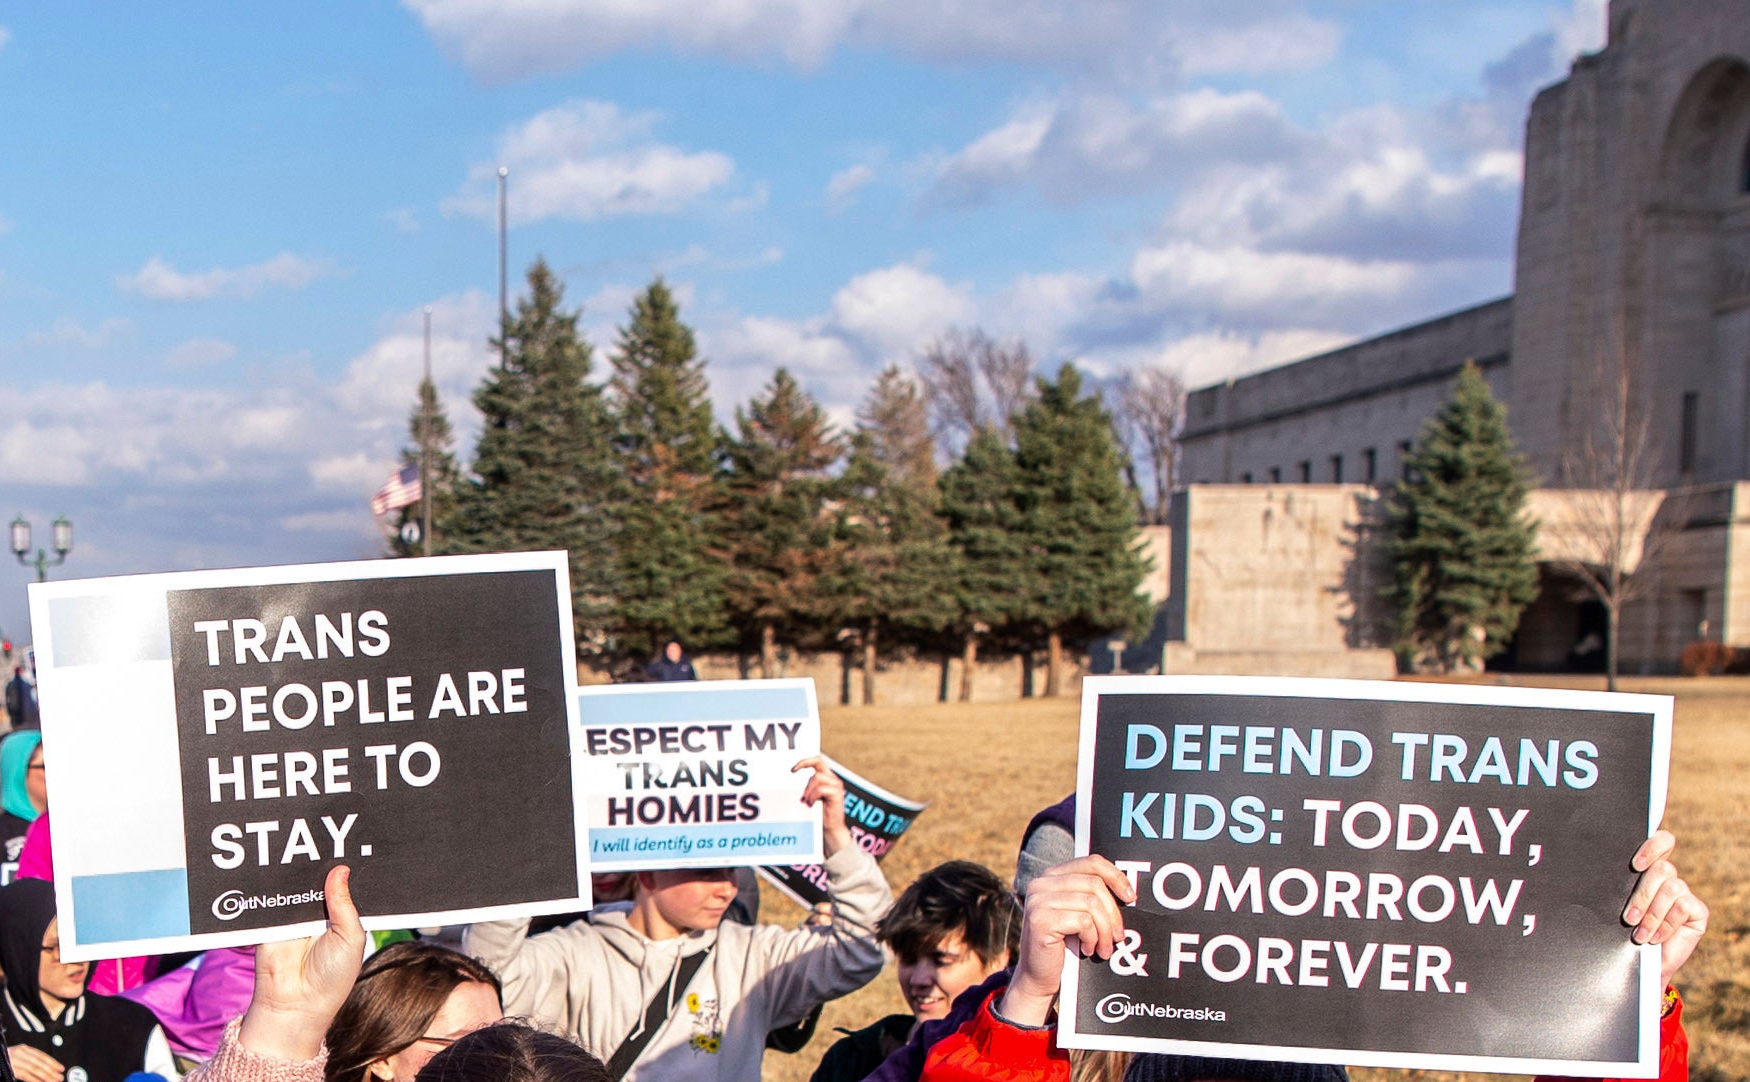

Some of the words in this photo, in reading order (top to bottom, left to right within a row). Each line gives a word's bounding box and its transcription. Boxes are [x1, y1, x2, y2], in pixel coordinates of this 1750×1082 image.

[193, 609, 391, 667] TRANS
[202, 675, 415, 735] PEOPLE
[428, 667, 528, 720] ARE
[584, 724, 732, 756] ESPECT
[744, 722, 802, 751] MY
[1124, 723, 1374, 778] DEFEND
[1392, 731, 1600, 790] TRANS
[206, 747, 352, 803] HERE
[363, 741, 442, 790] TO
[616, 758, 749, 790] TRANS
[607, 792, 761, 826] HOMIES
[1119, 791, 1284, 845] KIDS:
[1303, 798, 1543, 868] TODAY,
[210, 813, 373, 870] STAY.
[593, 839, 599, 853] I
[602, 837, 629, 852] will
[634, 835, 692, 854] identify
[696, 838, 714, 849] as
[718, 838, 727, 849] a
[731, 833, 797, 852] problem
[1115, 860, 1537, 938] TOMORROW,
[1109, 929, 1149, 977] &
[1168, 932, 1468, 994] FOREVER.
